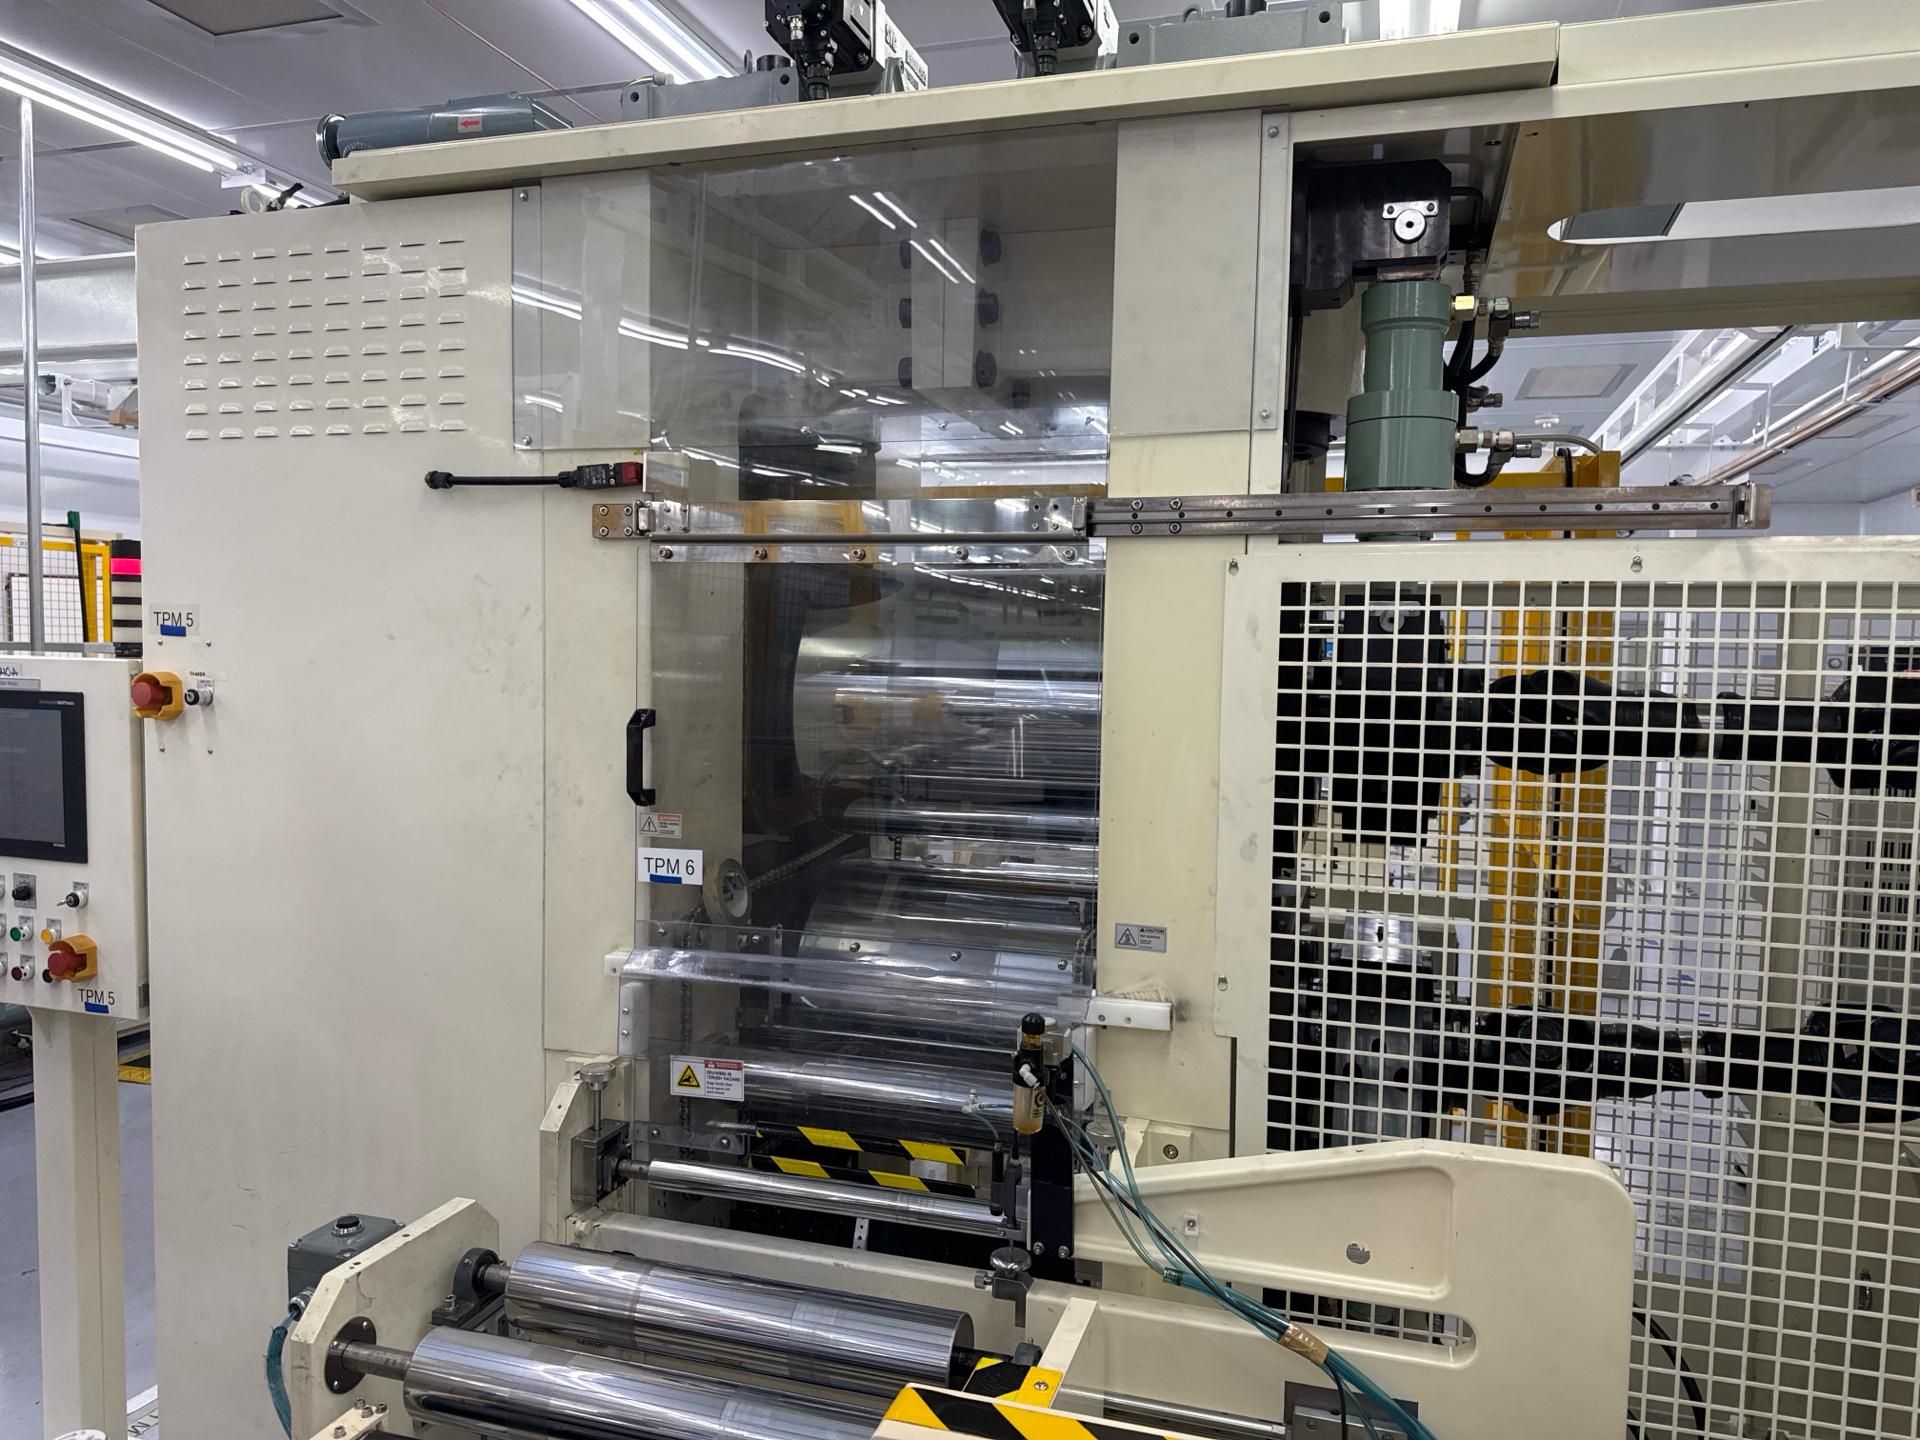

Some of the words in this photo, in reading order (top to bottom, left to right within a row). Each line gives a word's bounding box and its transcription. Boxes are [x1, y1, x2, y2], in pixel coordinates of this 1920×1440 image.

[153, 611, 182, 628] TPM
[186, 612, 194, 627] 5
[643, 857, 680, 875] TPM
[685, 859, 695, 876] 6
[78, 989, 104, 1004] TPM
[108, 991, 115, 1006] 5
